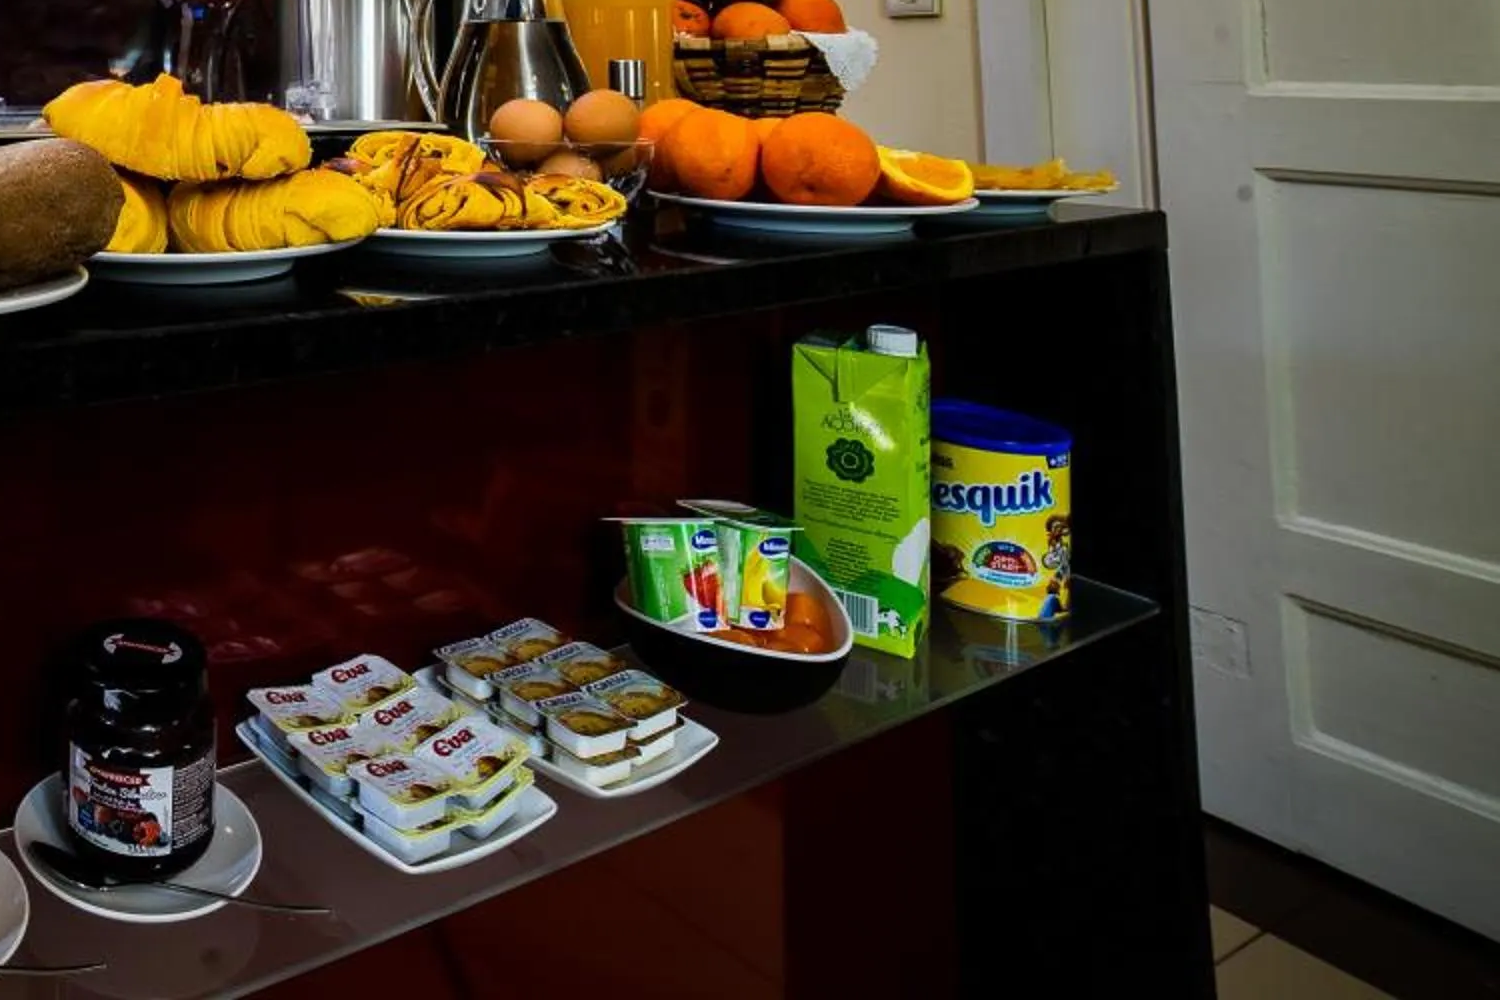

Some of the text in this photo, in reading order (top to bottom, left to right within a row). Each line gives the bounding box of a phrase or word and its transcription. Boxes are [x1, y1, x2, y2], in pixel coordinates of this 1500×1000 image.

[932, 470, 1053, 525] esquik
[332, 663, 371, 683] Eva
[266, 691, 308, 704] Eva
[374, 700, 415, 725] Eva
[308, 728, 351, 745] Eva
[433, 729, 476, 756] Eva
[366, 760, 409, 777] Eva
